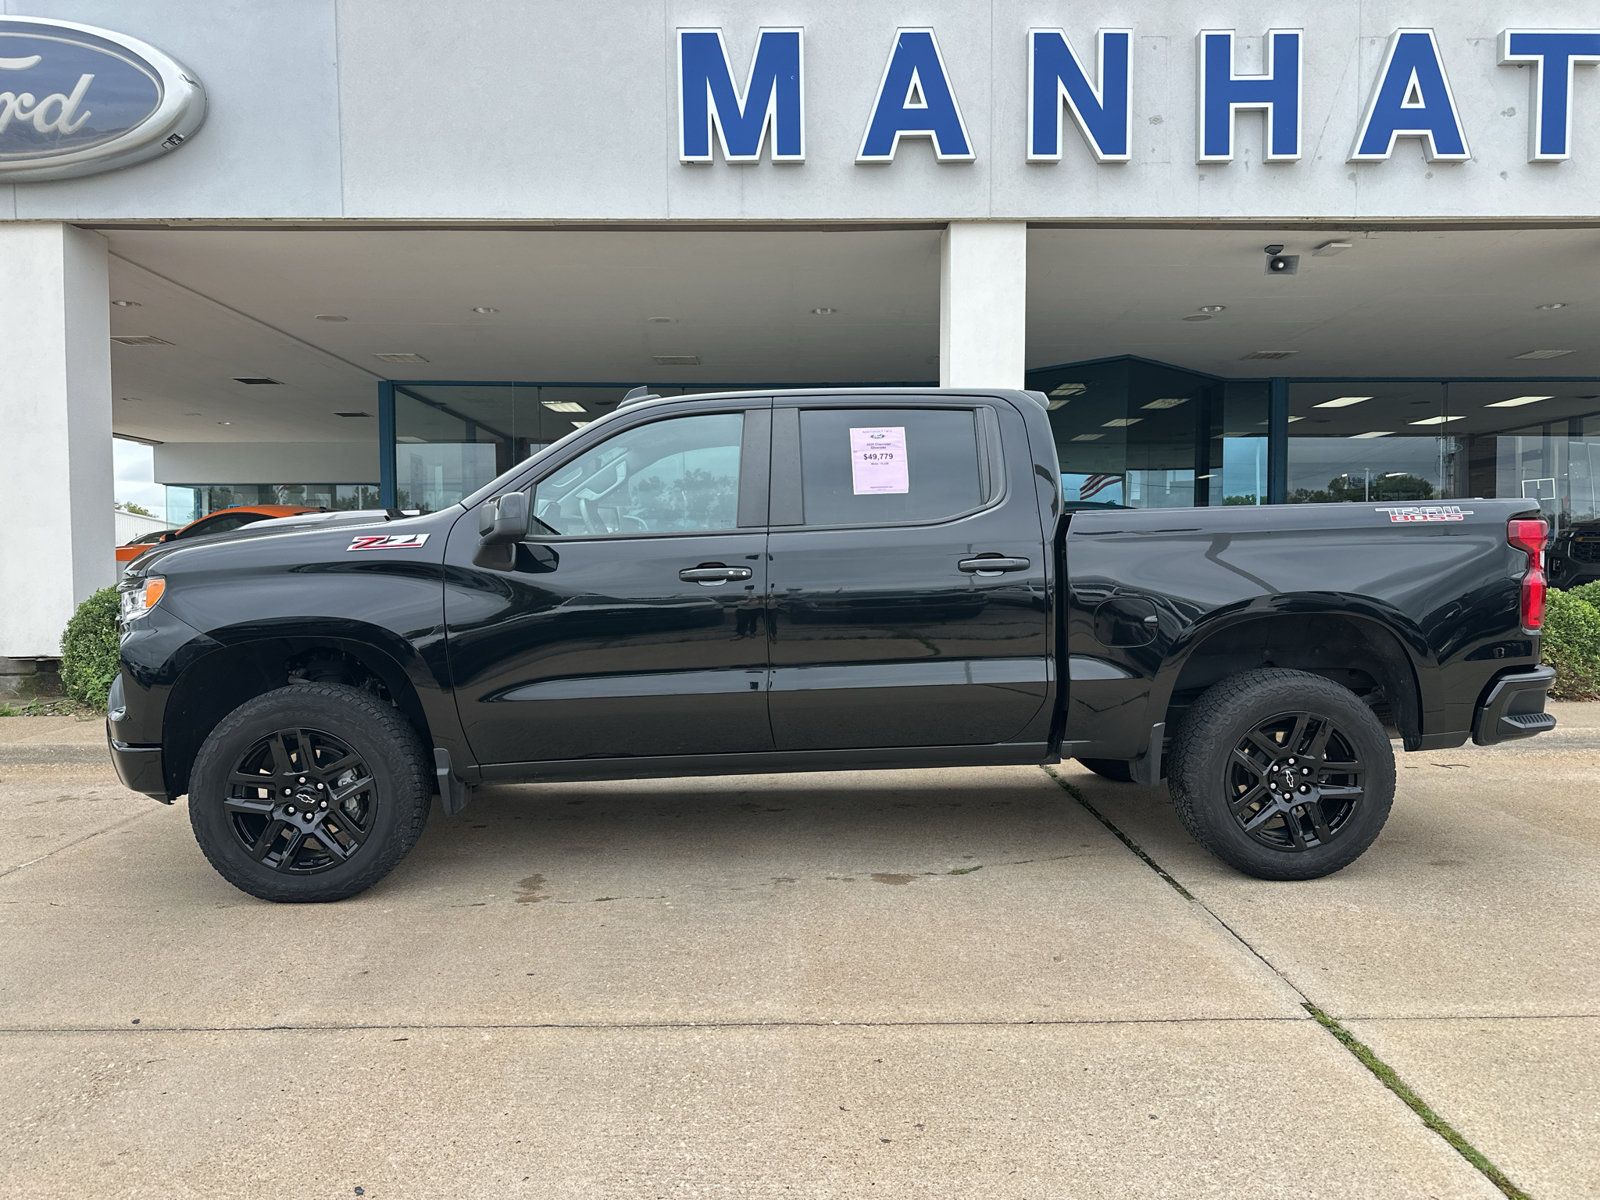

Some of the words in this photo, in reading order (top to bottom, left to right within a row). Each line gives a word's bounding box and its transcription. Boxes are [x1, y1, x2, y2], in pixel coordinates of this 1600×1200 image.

[676, 26, 1600, 165] MANHAT
[863, 453, 894, 461] $49,779
[1375, 506, 1474, 516] TRAIL
[1391, 514, 1464, 522] BOSS
[346, 533, 431, 552] Z71
